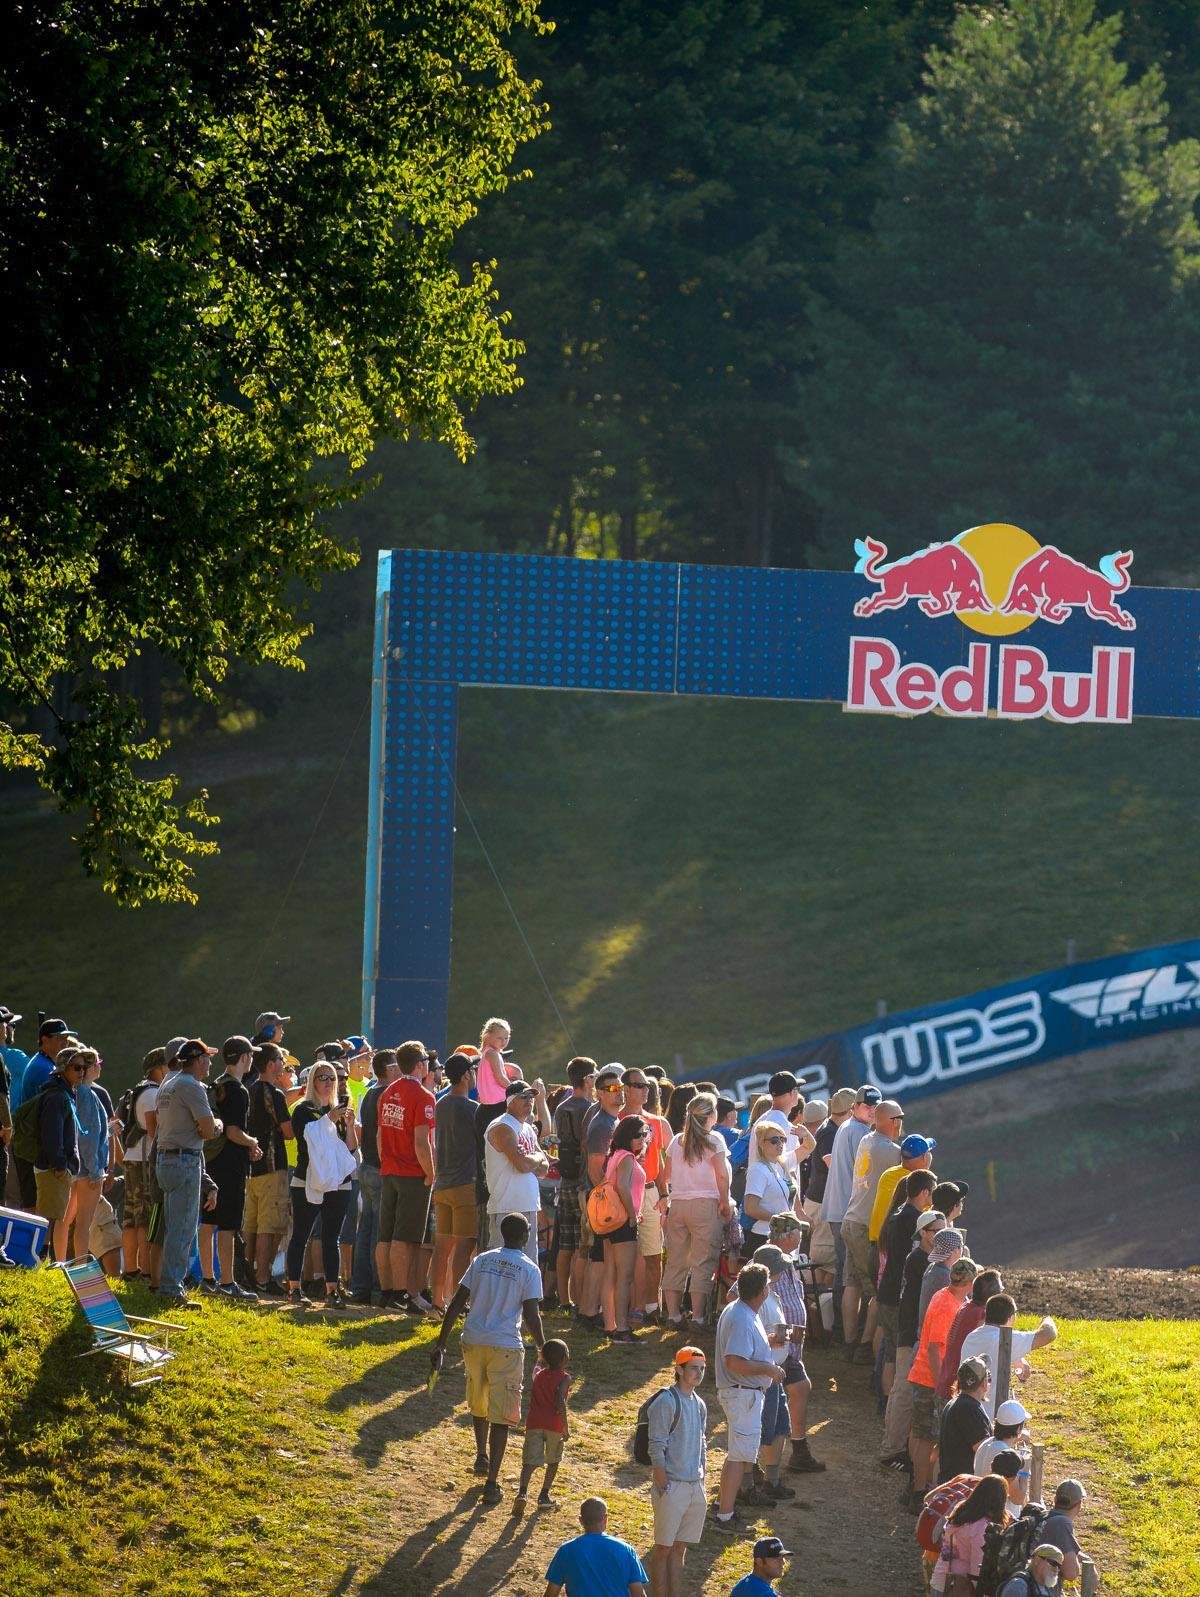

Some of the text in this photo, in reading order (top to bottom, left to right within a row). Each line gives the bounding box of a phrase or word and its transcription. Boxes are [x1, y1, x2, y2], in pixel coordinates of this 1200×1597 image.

[850, 637, 1134, 723] Red Bull
[862, 990, 1046, 1093] WPS
